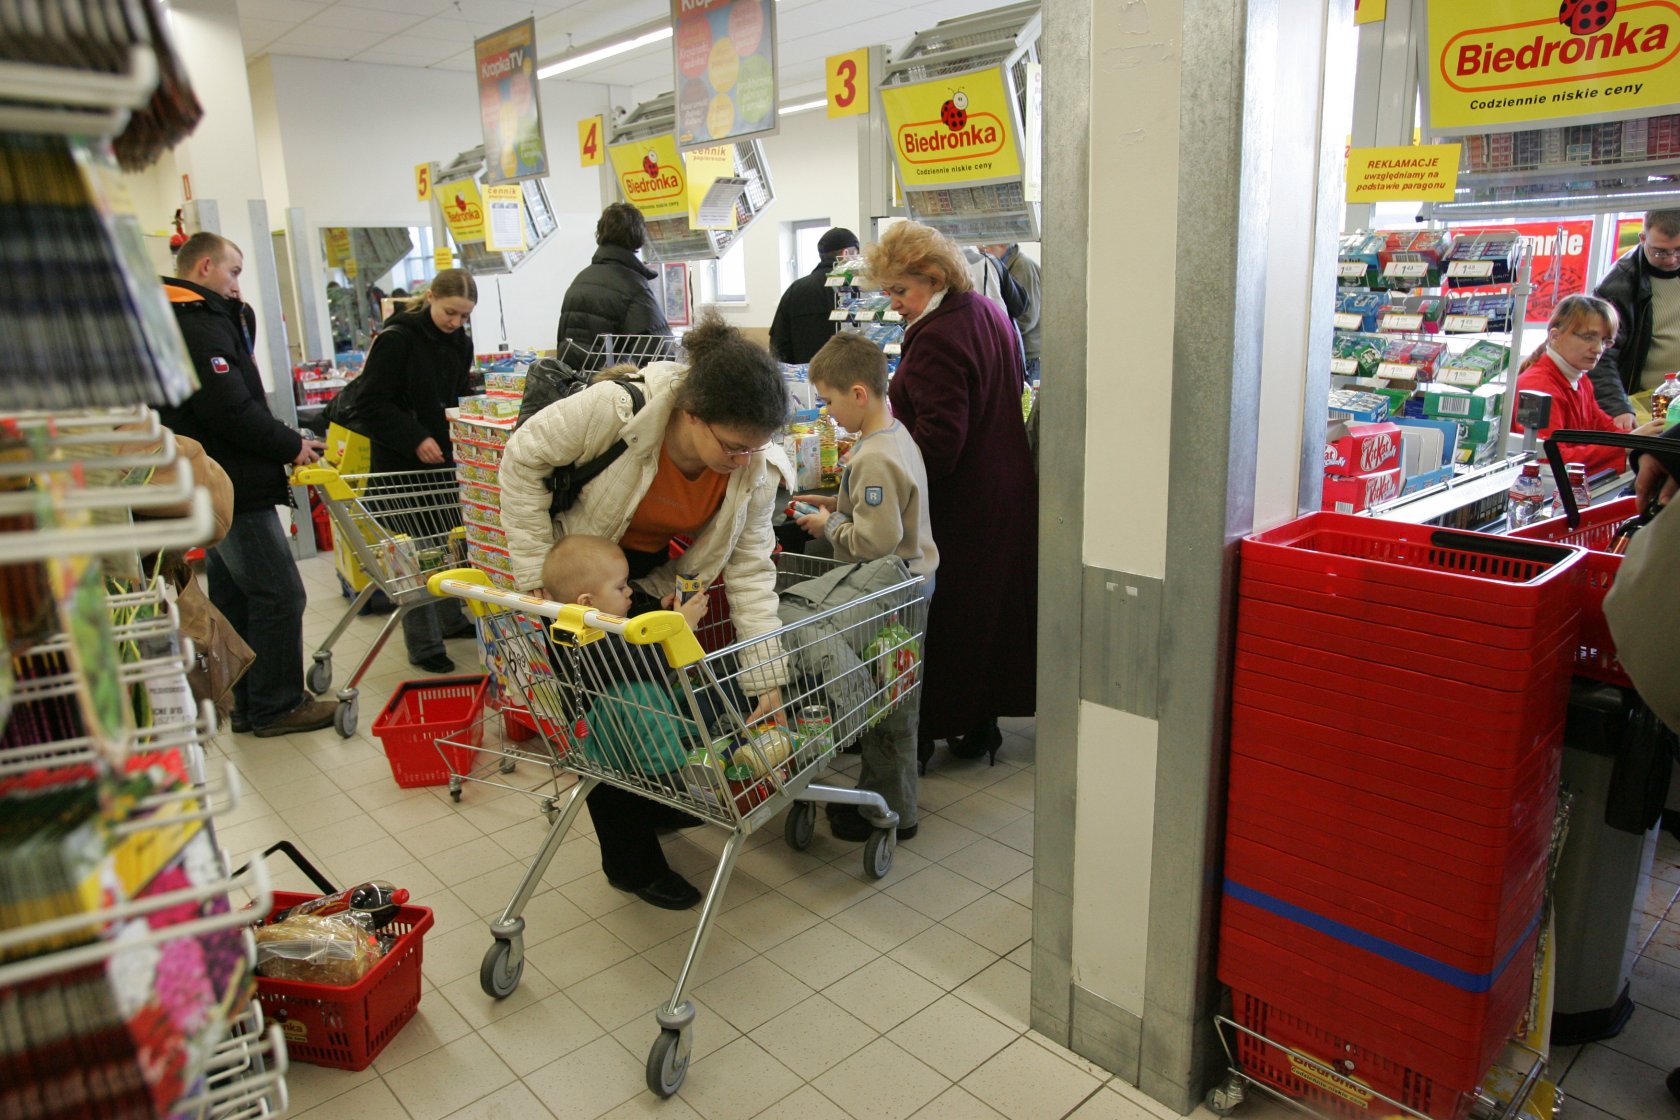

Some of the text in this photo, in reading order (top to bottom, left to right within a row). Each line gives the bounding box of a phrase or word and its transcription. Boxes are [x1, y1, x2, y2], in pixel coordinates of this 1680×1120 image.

[1456, 21, 1669, 77] Biedronka
[834, 59, 857, 108] 3
[1470, 83, 1644, 110] Codziennie niskie ceny
[583, 122, 598, 159] 4
[904, 124, 997, 154] Biedronka
[916, 161, 992, 176] Codziennie niskie ceny
[1367, 158, 1440, 169] REKLAMACJE
[419, 168, 427, 196] 5
[626, 173, 679, 194] Biedronka
[1356, 182, 1446, 192] podstawie paragonu
[1364, 171, 1426, 182] uwzględniamy
[869, 492, 877, 500] R
